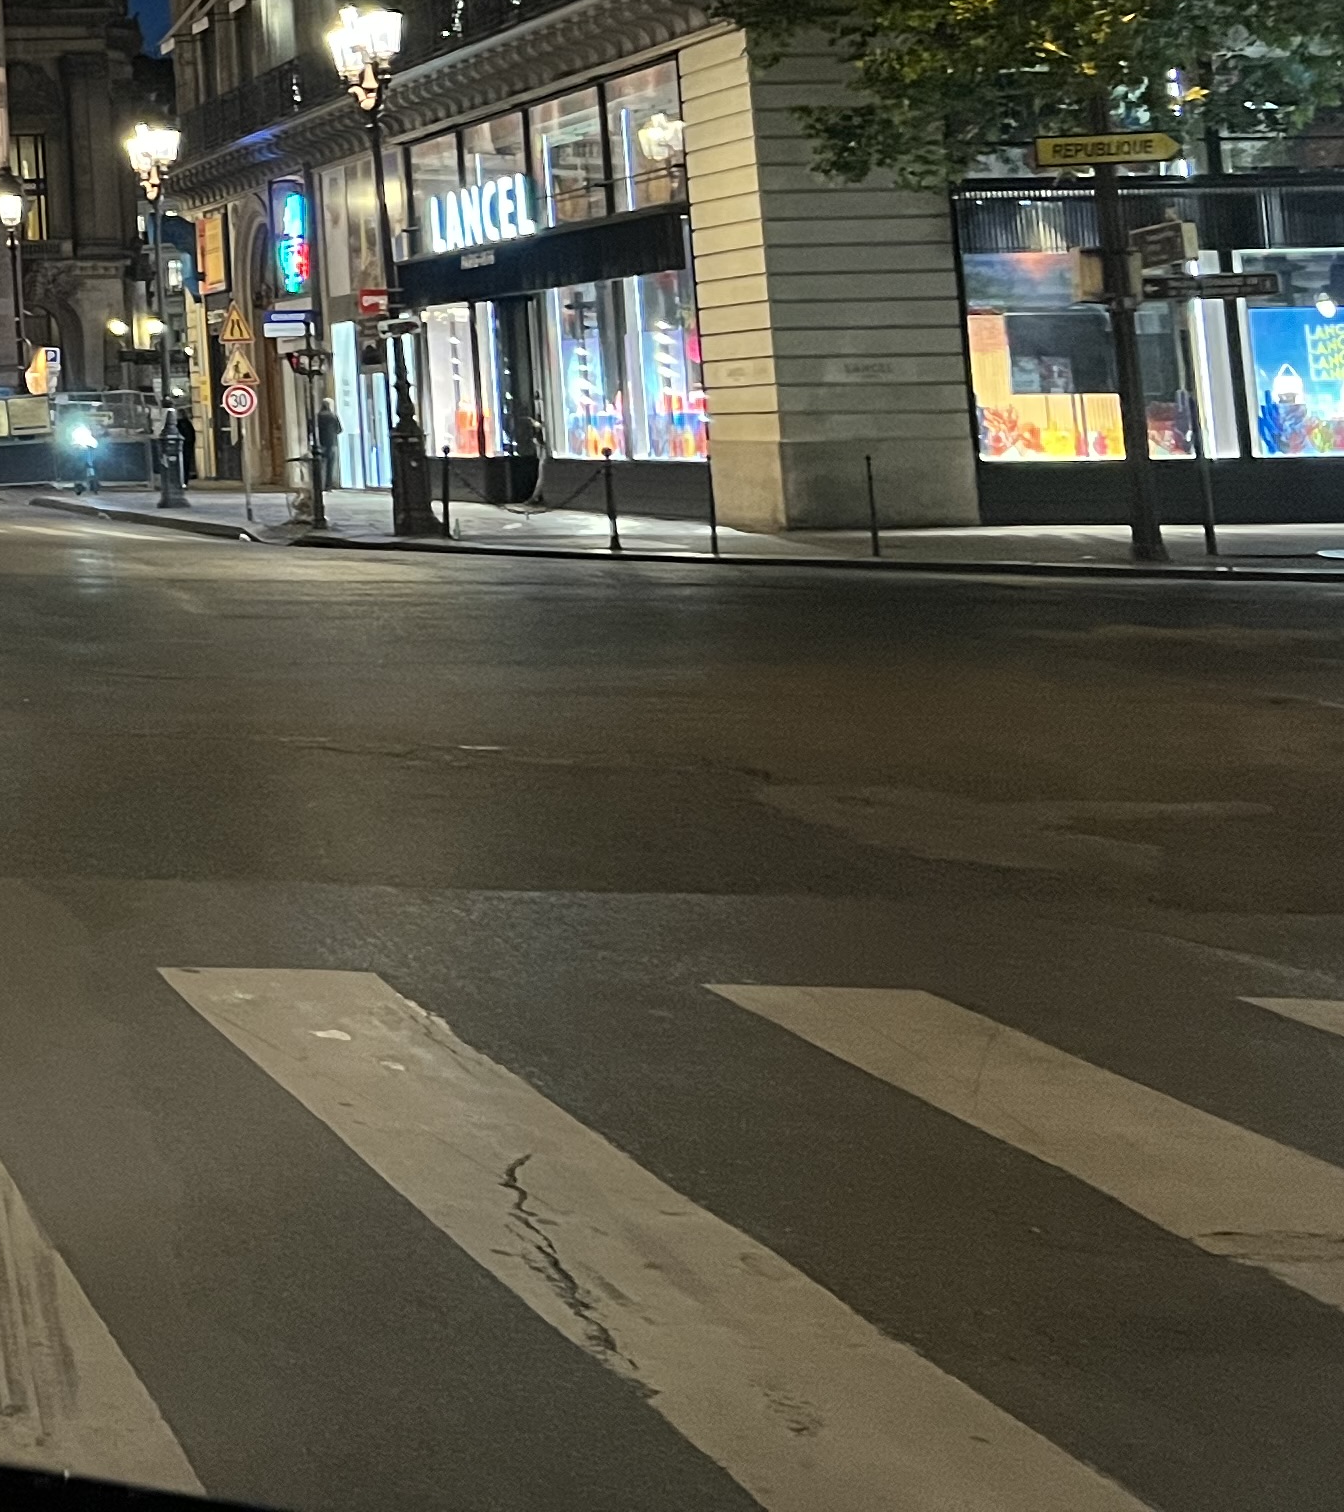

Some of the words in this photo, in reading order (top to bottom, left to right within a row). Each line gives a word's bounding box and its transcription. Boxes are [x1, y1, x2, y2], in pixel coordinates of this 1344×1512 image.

[1052, 139, 1154, 159] REPUBLIQUE
[430, 173, 536, 253] LANCEL
[230, 393, 247, 408] 30
